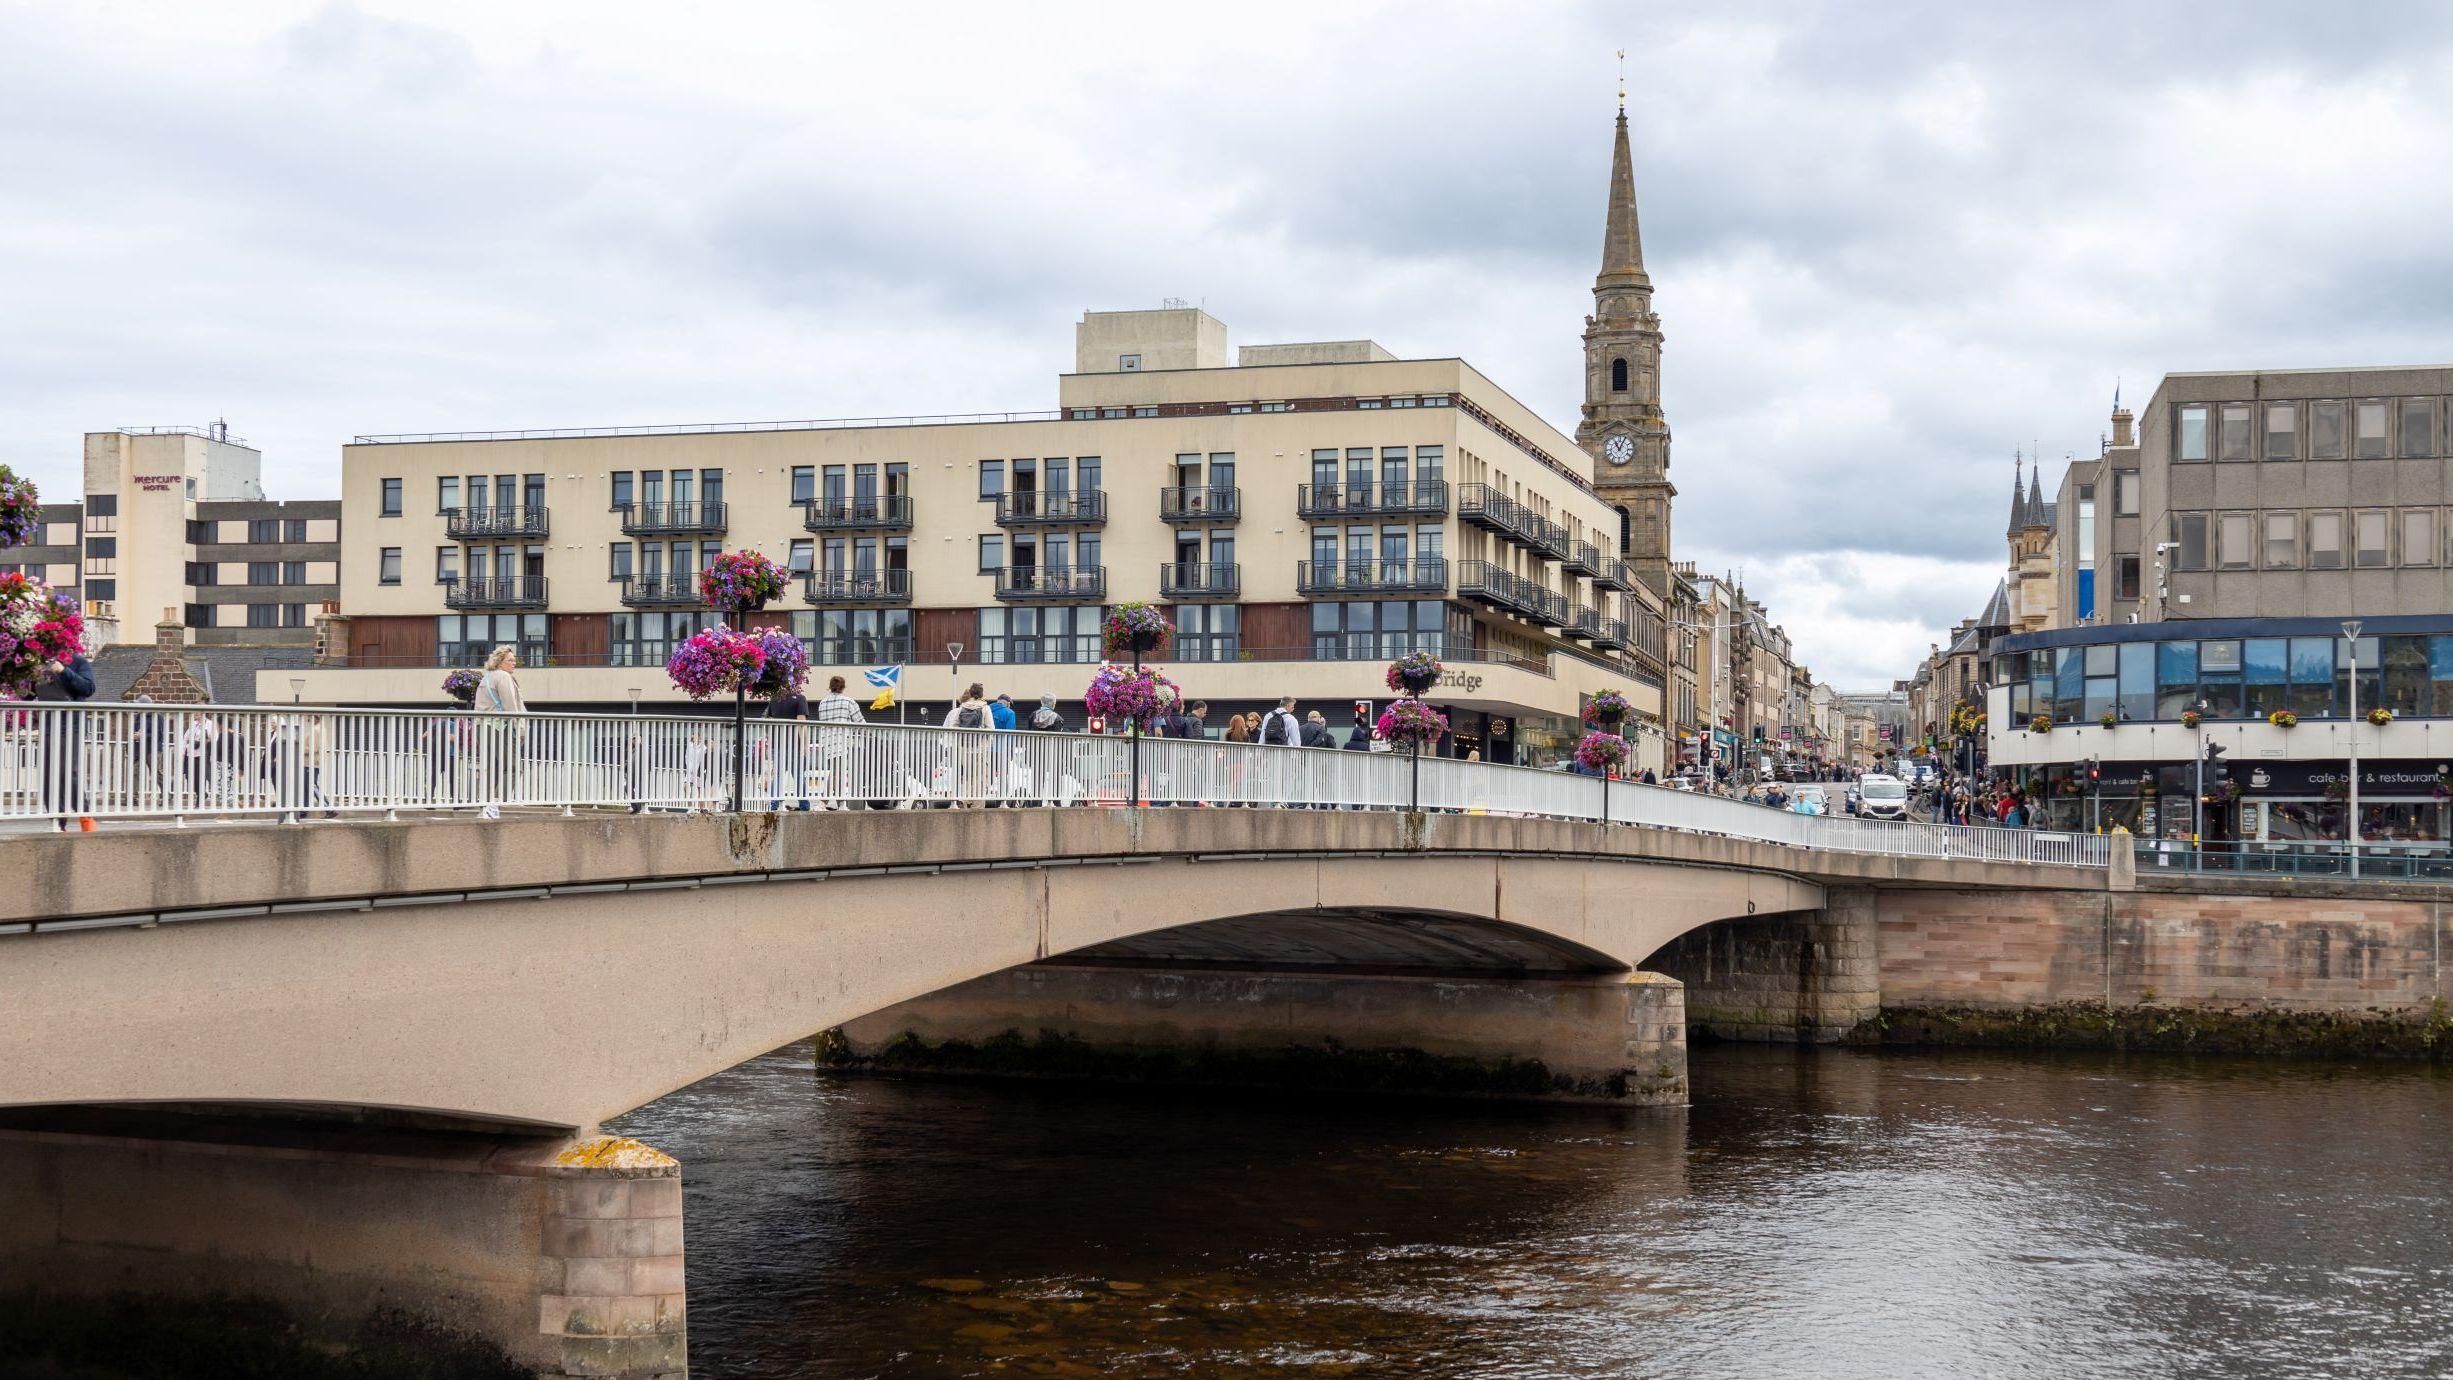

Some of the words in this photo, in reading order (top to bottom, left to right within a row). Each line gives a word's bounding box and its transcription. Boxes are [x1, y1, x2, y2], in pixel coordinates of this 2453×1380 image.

[2309, 772, 2336, 783] cafe
[2340, 773, 2362, 783] br
[2366, 773, 2376, 783] &
[2380, 772, 2440, 783] restaurant
